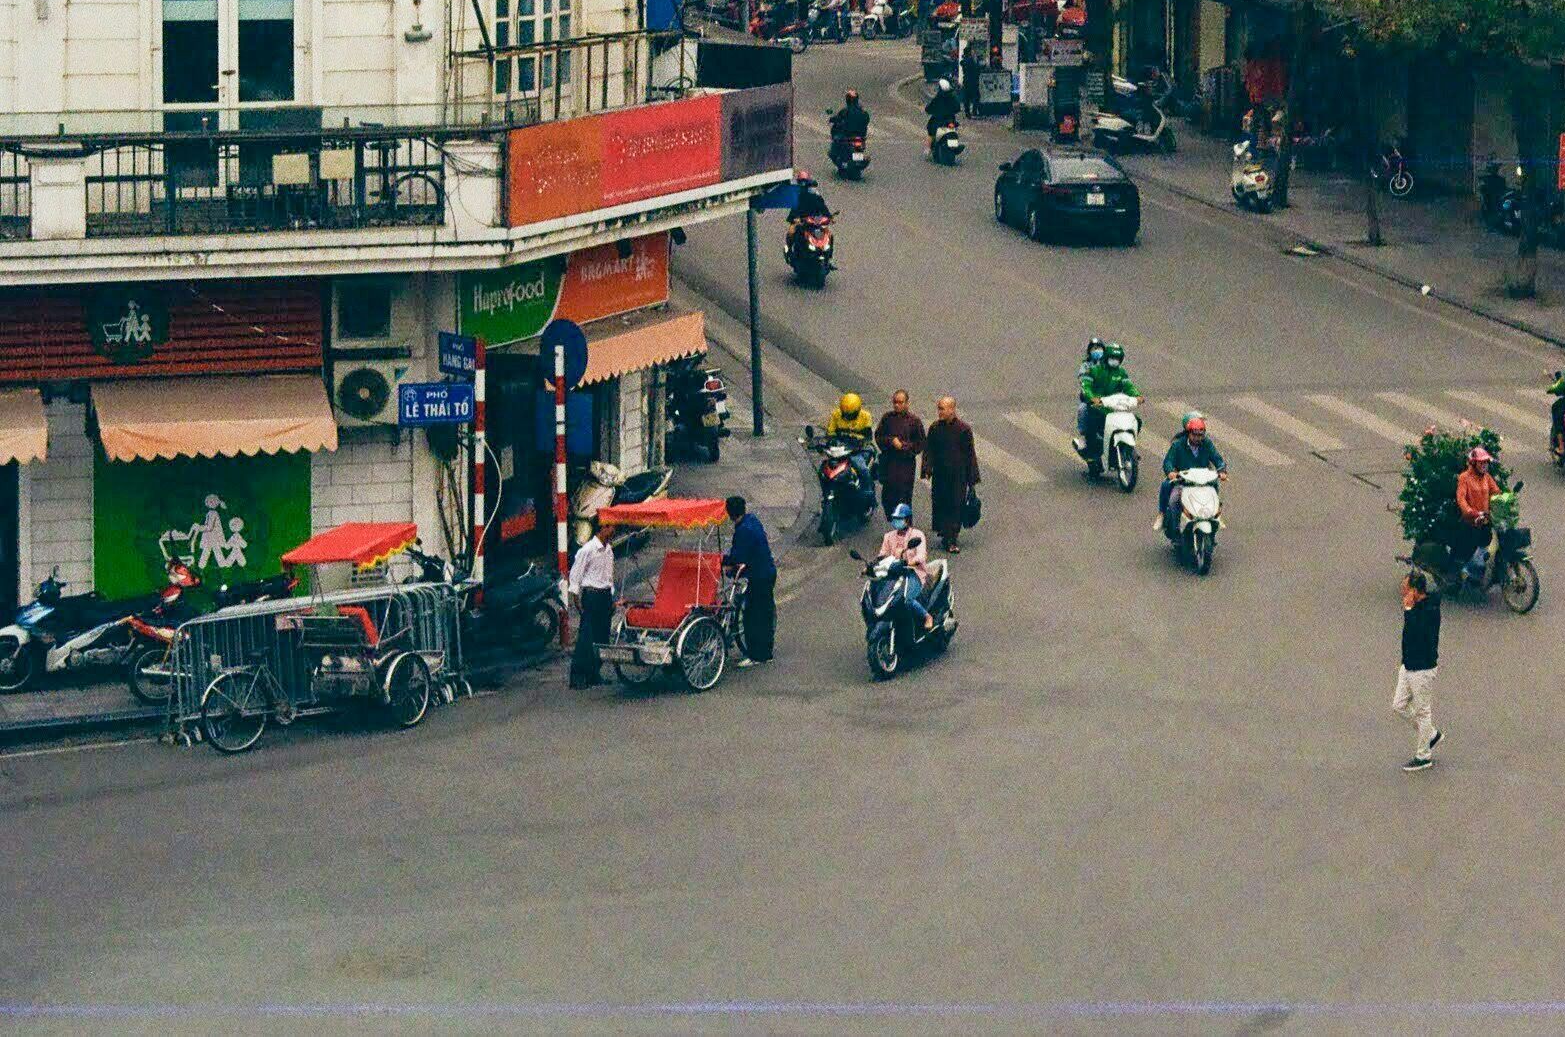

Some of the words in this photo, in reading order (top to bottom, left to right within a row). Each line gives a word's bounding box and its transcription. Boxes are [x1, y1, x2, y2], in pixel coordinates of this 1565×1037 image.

[426, 387, 448, 399] PHỐ
[405, 400, 420, 418] LÊ
[423, 400, 451, 417] THÁI
